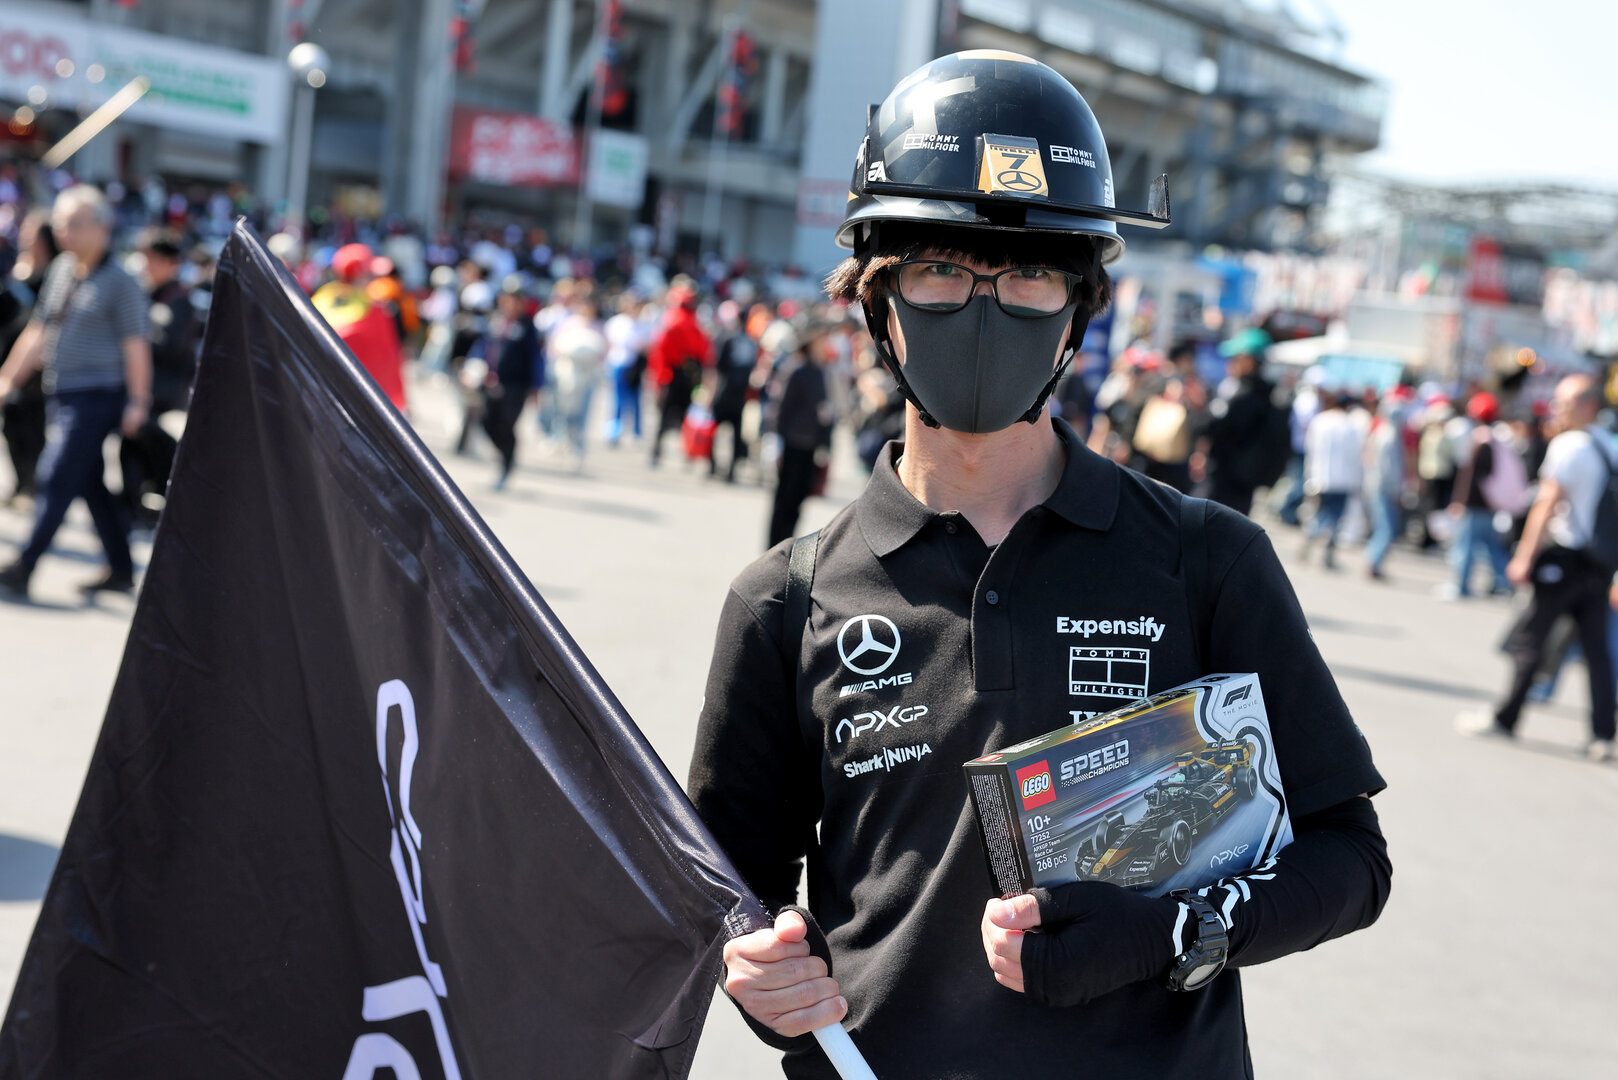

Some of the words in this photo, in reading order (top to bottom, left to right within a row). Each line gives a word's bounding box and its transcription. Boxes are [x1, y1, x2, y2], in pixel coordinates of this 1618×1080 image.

[921, 141, 960, 153] HILFIGER
[924, 133, 960, 143] TOMMY
[1001, 152, 1029, 170] 7
[1068, 147, 1093, 159] TOMMY
[1056, 615, 1166, 642] Expensify
[1075, 649, 1146, 660] TOMMY
[1073, 684, 1144, 697] HILFIGER
[1223, 708, 1236, 717] THE
[1237, 699, 1259, 711] MOVIE
[1060, 738, 1130, 781] SPEED
[1022, 772, 1050, 798] LEGO
[1027, 815, 1051, 833] 10+
[1030, 831, 1051, 844] 77252
[1036, 857, 1053, 872] 268
[1053, 854, 1068, 869] pcs
